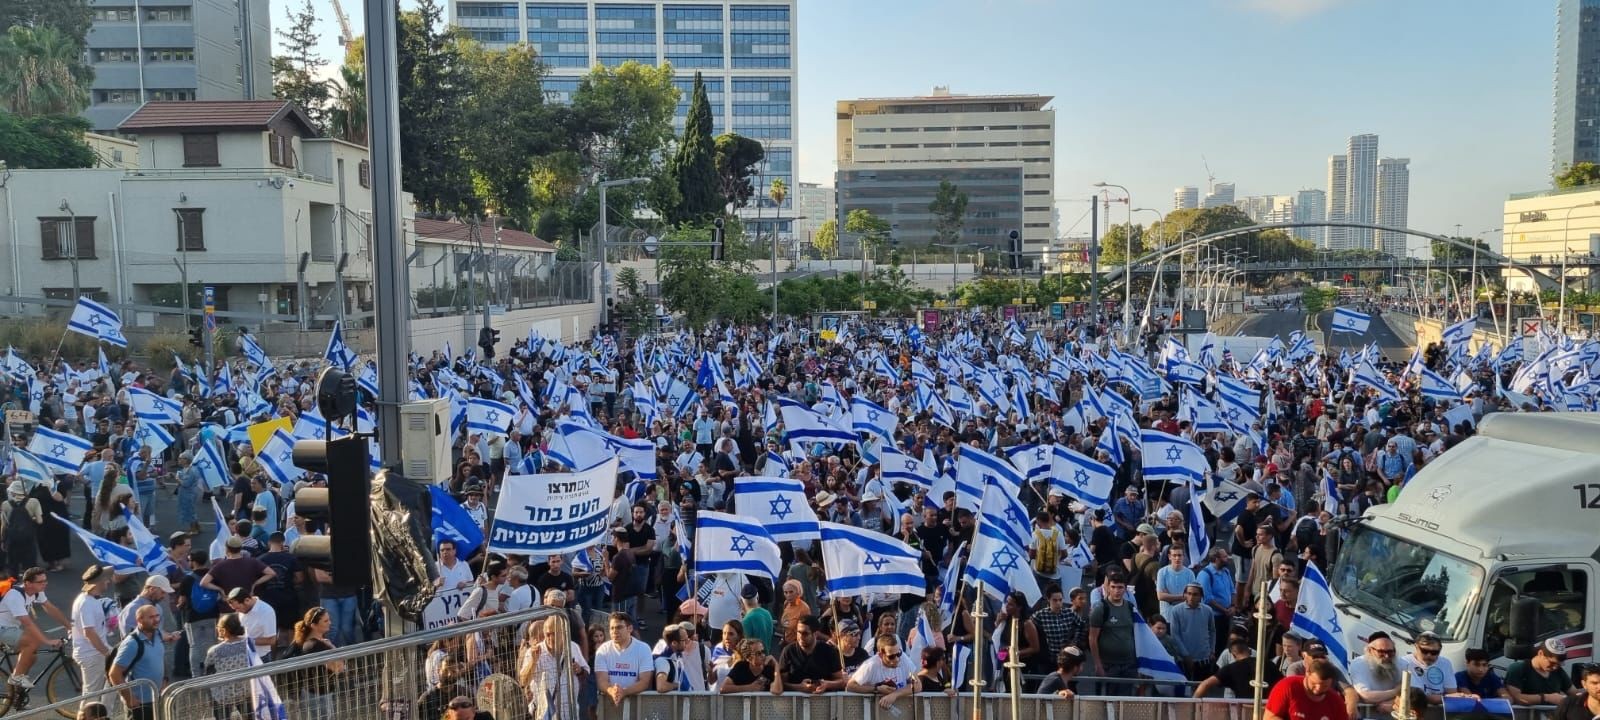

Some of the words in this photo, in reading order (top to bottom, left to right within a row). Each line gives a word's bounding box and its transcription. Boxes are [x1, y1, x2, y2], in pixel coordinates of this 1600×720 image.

[525, 505, 563, 522] בחר
[569, 497, 600, 519] העם
[494, 527, 566, 545] משפטית
